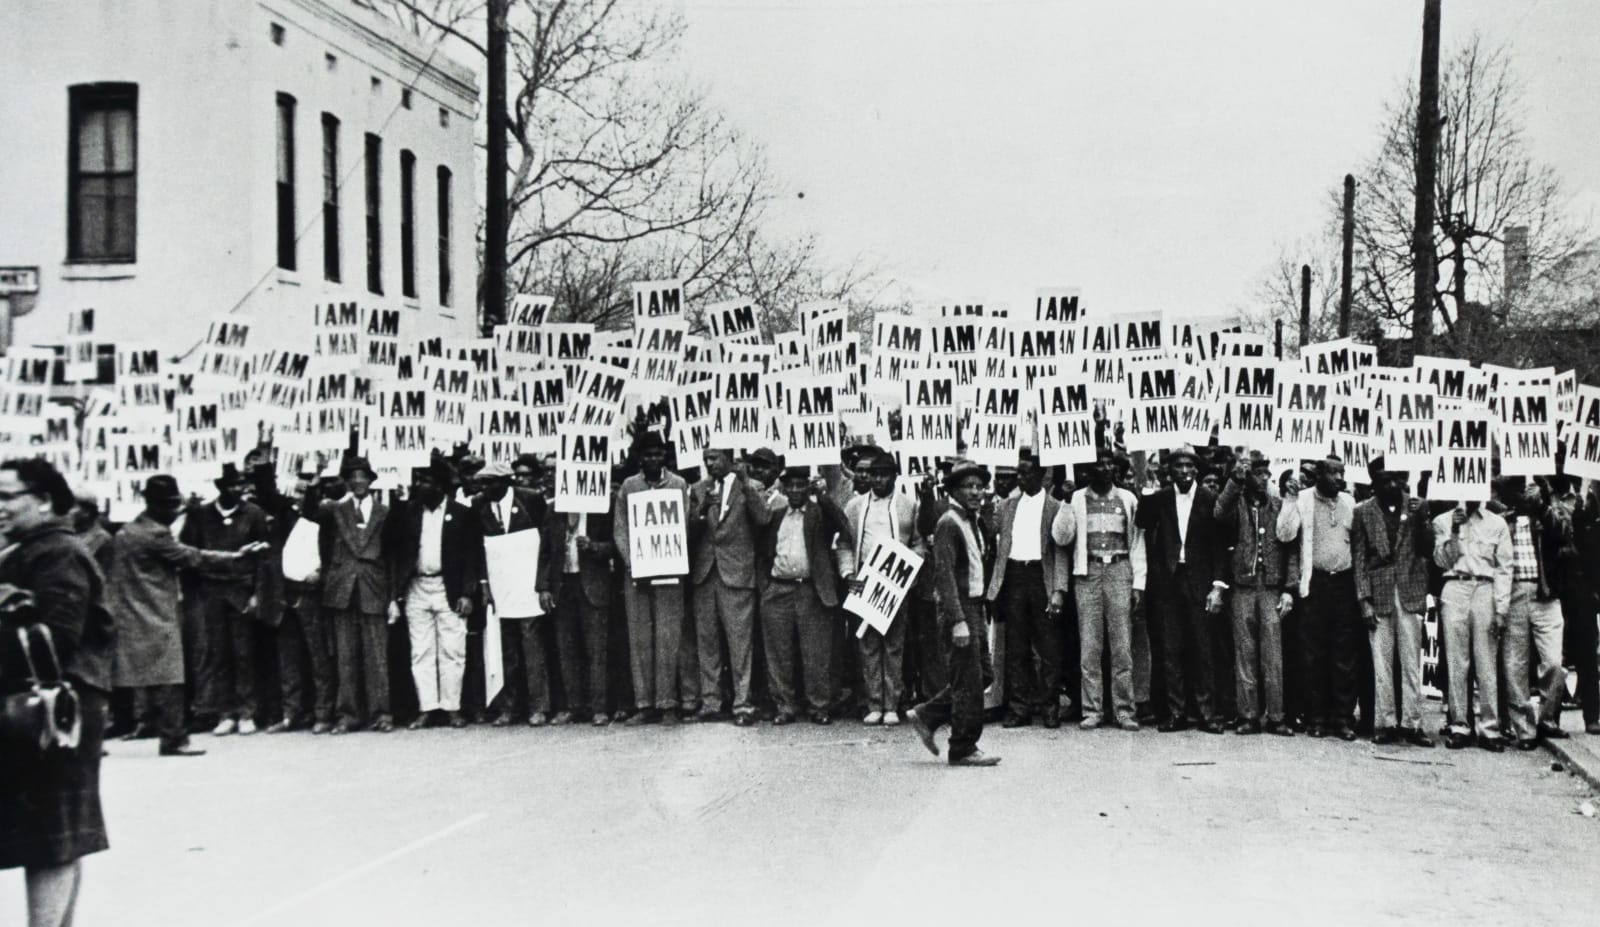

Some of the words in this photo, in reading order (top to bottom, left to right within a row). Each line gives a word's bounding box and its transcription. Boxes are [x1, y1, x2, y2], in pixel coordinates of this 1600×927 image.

[315, 305, 319, 325] I
[325, 302, 357, 325] AM
[511, 303, 518, 322] I
[517, 304, 547, 325] AM
[637, 292, 642, 315] I
[648, 289, 679, 316] AM
[1036, 297, 1041, 320] I
[1045, 296, 1078, 320] AM
[367, 309, 399, 335] AM
[711, 314, 718, 336] I
[723, 306, 755, 335] AM
[817, 319, 843, 346] AM
[207, 322, 215, 343] I
[215, 323, 249, 347] AM
[315, 334, 321, 355] A
[329, 333, 357, 355] MAN
[506, 332, 512, 352] A
[516, 331, 541, 354] MAN
[548, 333, 552, 356] I
[558, 333, 590, 358] AM
[637, 328, 644, 349] I
[647, 329, 683, 353] AM
[878, 323, 882, 346] I
[888, 325, 921, 352] AM
[932, 327, 938, 352] I
[944, 325, 975, 352] AM
[1009, 332, 1014, 356] I
[1021, 331, 1055, 356] AM
[1083, 326, 1088, 349] I
[1114, 324, 1120, 349] I
[1126, 321, 1160, 348] AM
[1173, 325, 1177, 345] I
[119, 352, 123, 375] I
[129, 350, 158, 376] AM
[275, 352, 309, 378] AM
[368, 341, 397, 365] MAN
[818, 351, 842, 375] MAN
[1318, 348, 1348, 374] AM
[18, 359, 48, 384] AM
[632, 357, 639, 378] A
[645, 358, 676, 382] MAN
[875, 355, 881, 378] A
[308, 379, 311, 402] I
[316, 375, 346, 402] AM
[433, 369, 468, 394] AM
[522, 382, 527, 405] I
[533, 379, 564, 405] AM
[578, 370, 588, 393] I
[588, 373, 624, 402] AM
[716, 374, 720, 398] I
[726, 373, 759, 398] AM
[906, 380, 910, 405] I
[917, 380, 951, 405] AM
[1128, 373, 1133, 398] I
[1140, 370, 1176, 398] AM
[1224, 367, 1229, 393] I
[1236, 368, 1274, 394] AM
[1430, 370, 1464, 396] AM
[121, 385, 126, 405] A
[134, 384, 159, 405] MAN
[272, 383, 302, 409] MAN
[380, 392, 384, 416] I
[391, 391, 424, 416] AM
[786, 389, 791, 415] I
[798, 387, 833, 414] AM
[985, 389, 1019, 414] AM
[1040, 389, 1045, 414] I
[1052, 384, 1087, 413] AM
[1277, 383, 1283, 408] I
[1289, 384, 1326, 410] AM
[1387, 394, 1391, 419] I
[1399, 394, 1433, 419] AM
[177, 409, 181, 432] I
[187, 404, 217, 430] AM
[306, 412, 312, 434] A
[319, 409, 345, 433] MAN
[434, 400, 465, 424] MAN
[569, 403, 578, 424] A
[582, 404, 614, 426] MAN
[673, 398, 679, 422] I
[715, 408, 722, 432] A
[730, 408, 758, 432] MAN
[1132, 408, 1139, 433] A
[1146, 405, 1178, 432] MAN
[1181, 405, 1210, 432] MAN
[1223, 403, 1231, 429] A
[1239, 404, 1272, 431] MAN
[1330, 405, 1335, 430] I
[1339, 406, 1369, 434] AM
[1501, 397, 1506, 422] I
[1512, 397, 1547, 422] AM
[1576, 396, 1584, 422] I
[480, 413, 484, 434] I
[489, 411, 520, 435] AM
[525, 415, 532, 438] A
[789, 424, 797, 449] A
[804, 422, 835, 448] MAN
[907, 415, 914, 439] A
[922, 414, 952, 439] MAN
[972, 423, 979, 448] A
[986, 423, 1016, 449] MAN
[1044, 424, 1052, 449] A
[1058, 420, 1090, 447] MAN
[1275, 418, 1283, 443] A
[1291, 419, 1324, 444] MAN
[1438, 420, 1443, 447] I
[1449, 421, 1487, 447] AM
[191, 438, 216, 462] MAN
[381, 427, 387, 451] A
[395, 426, 425, 450] MAN
[561, 435, 566, 459] I
[573, 435, 608, 462] AM
[679, 430, 686, 454] A
[1389, 429, 1397, 454] A
[1505, 432, 1512, 458] A
[1518, 432, 1550, 458] MAN
[1570, 432, 1579, 458] A
[114, 445, 118, 469] I
[126, 445, 159, 470] AM
[492, 442, 520, 462] MAN
[1343, 441, 1369, 467] MAN
[561, 470, 568, 494] A
[576, 470, 606, 496] MAN
[1437, 457, 1445, 483] A
[1454, 457, 1486, 483] MAN
[633, 503, 637, 527] I
[645, 500, 679, 525] AM
[637, 537, 643, 559] A
[651, 534, 682, 558] MAN
[869, 545, 882, 566] I
[879, 552, 914, 589] AM
[854, 575, 869, 599] A
[868, 582, 898, 618] MAN
